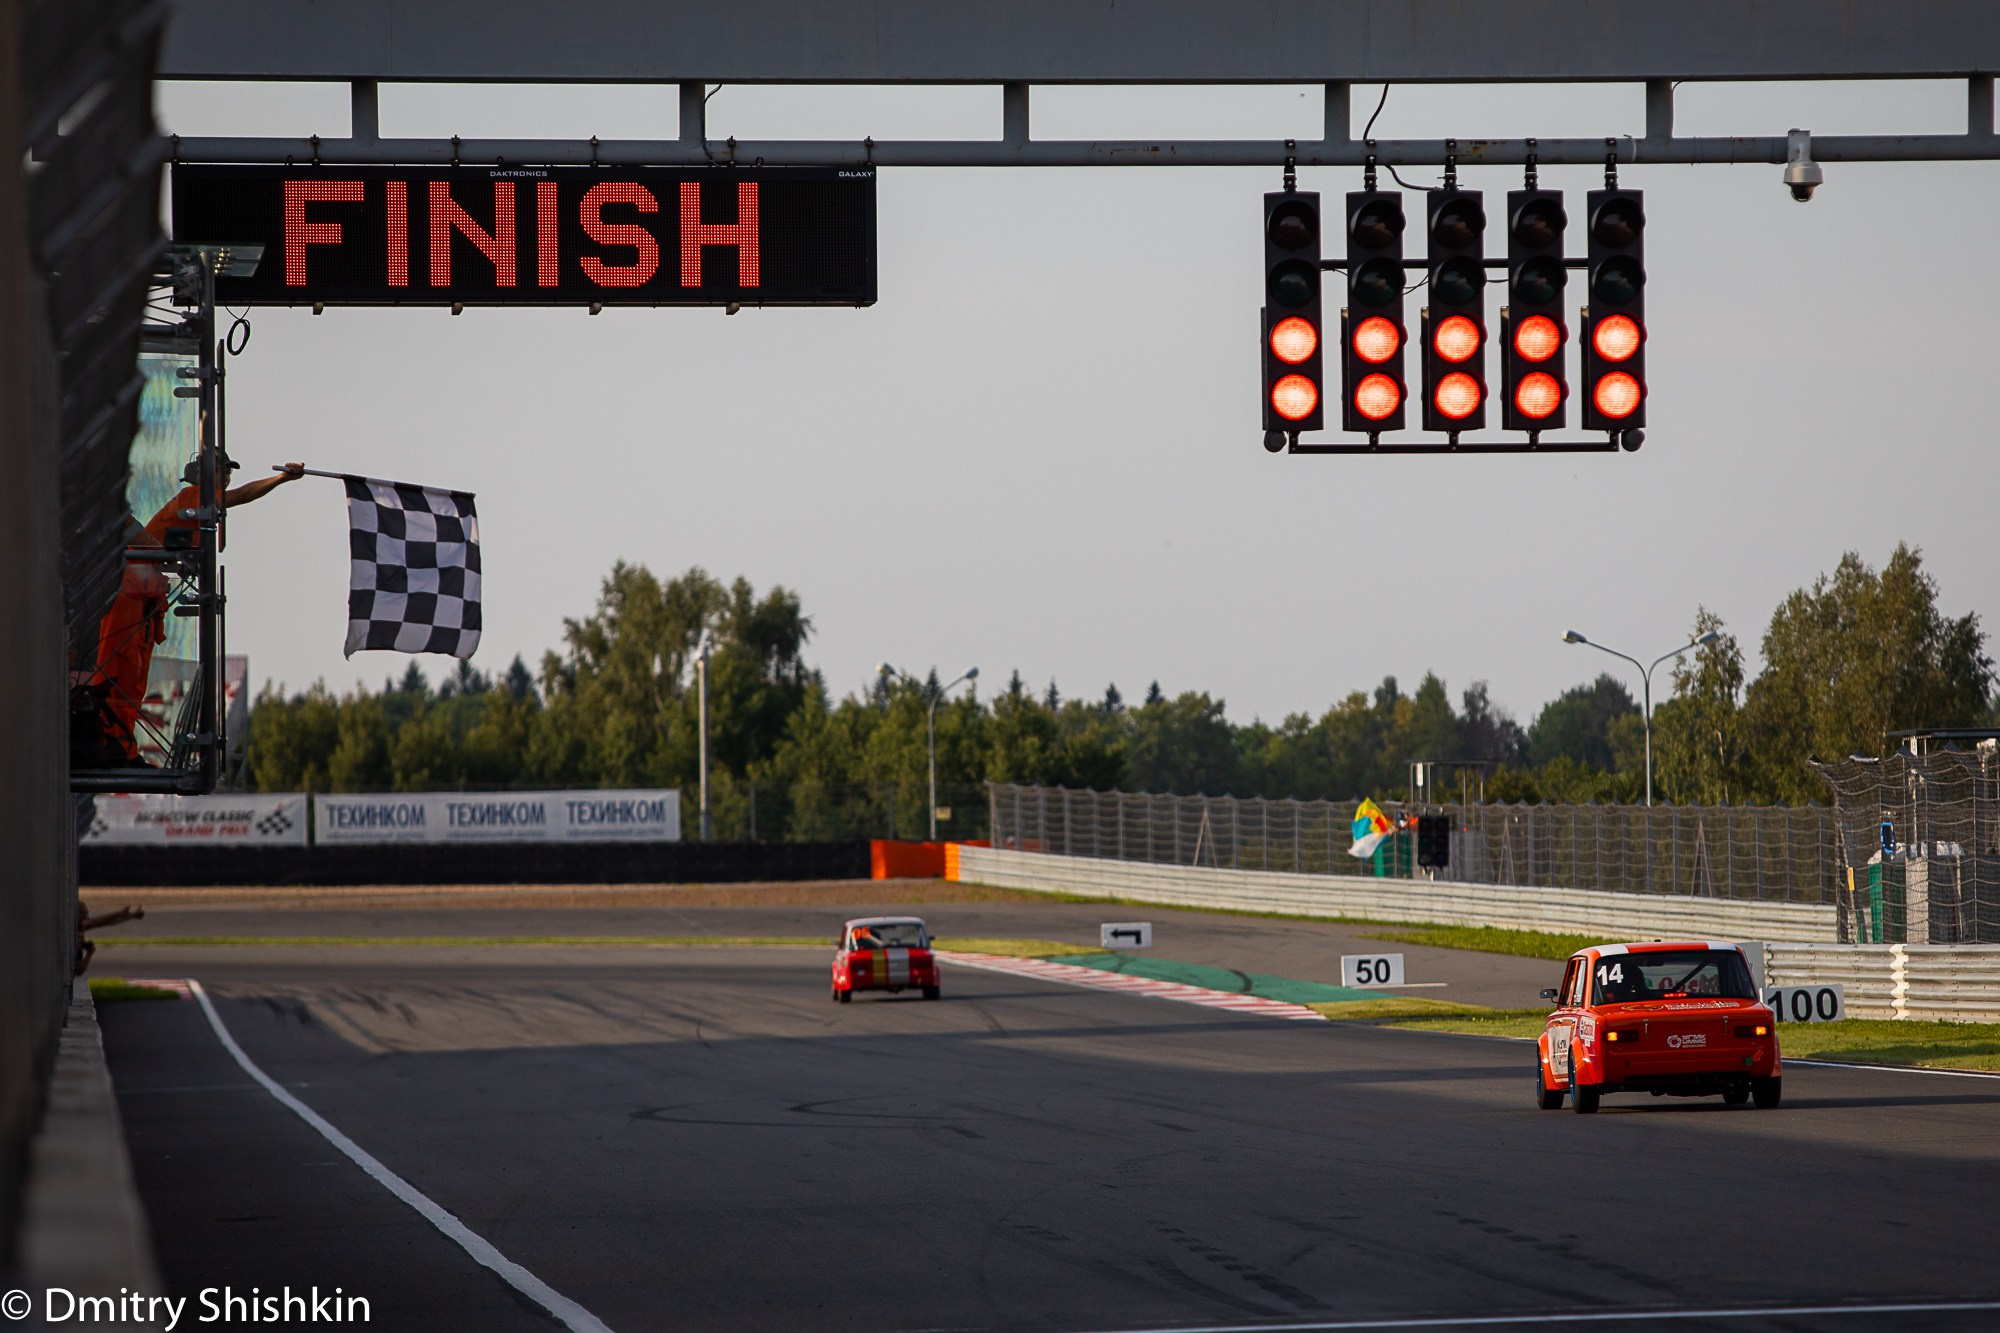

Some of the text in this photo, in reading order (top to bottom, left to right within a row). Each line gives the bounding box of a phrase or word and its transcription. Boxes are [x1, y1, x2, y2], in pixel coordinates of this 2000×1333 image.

[284, 180, 760, 288] FINISH
[326, 803, 426, 828] ТЕХИНКОМ
[447, 802, 546, 826] ТЕХИНКОМ
[566, 799, 666, 824] ТЕХИНКОМ
[1357, 959, 1391, 985] 50
[1597, 963, 1624, 986] 14
[1768, 988, 1838, 1022] 100
